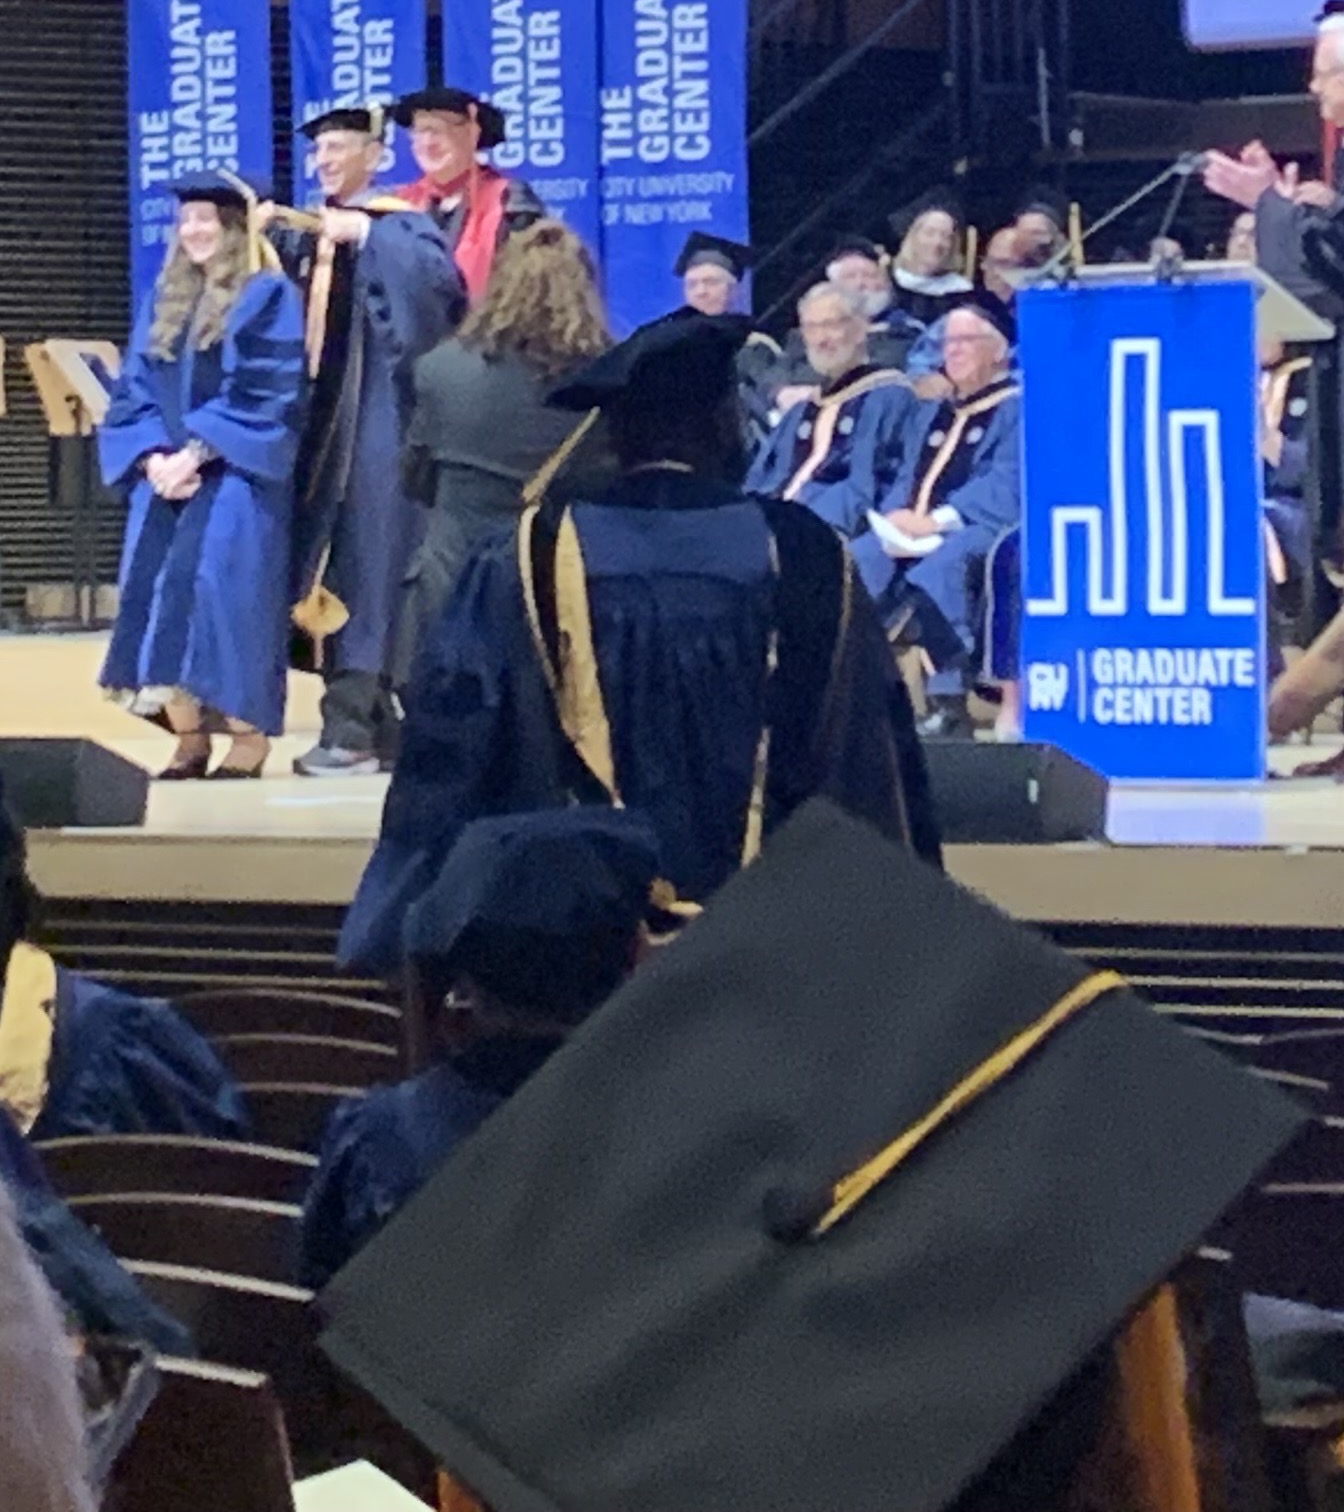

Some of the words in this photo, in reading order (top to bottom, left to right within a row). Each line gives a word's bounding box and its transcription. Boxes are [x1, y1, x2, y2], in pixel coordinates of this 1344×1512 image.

[527, 10, 565, 167] CENTER
[672, 2, 711, 162] CENTER
[140, 110, 169, 190] THE
[599, 85, 633, 165] THE
[639, 171, 735, 198] UNIVERSITY
[666, 199, 713, 223] YORK
[1092, 648, 1255, 686] GRADUATE
[1093, 687, 1212, 725] CENTER
